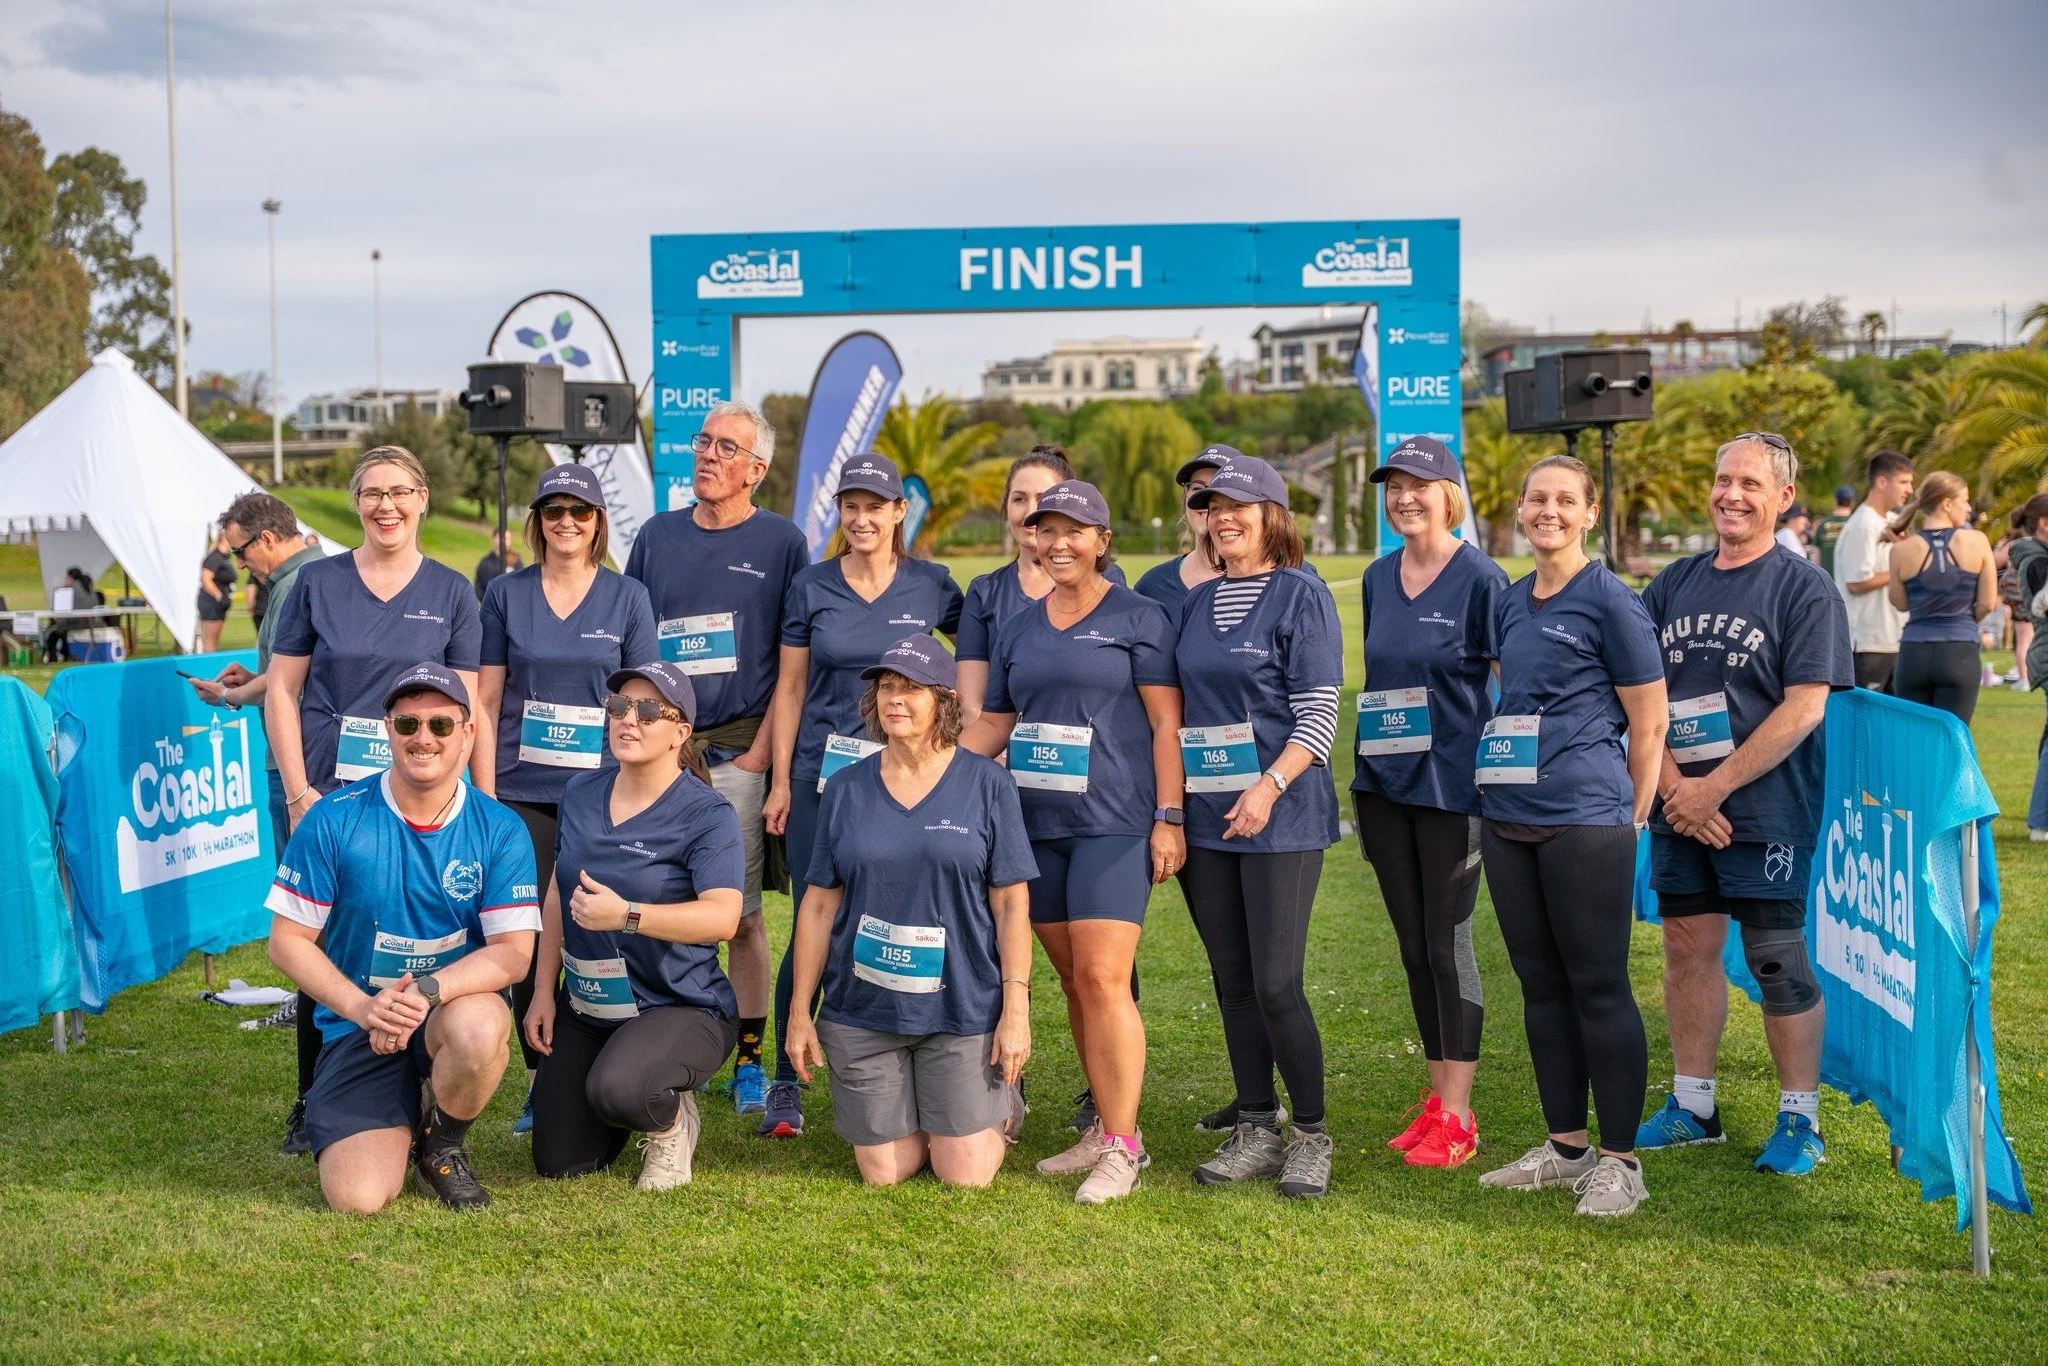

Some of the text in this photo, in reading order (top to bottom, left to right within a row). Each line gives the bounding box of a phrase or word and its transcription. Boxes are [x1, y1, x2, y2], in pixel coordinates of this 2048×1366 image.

[1315, 238, 1409, 270] Coastal
[1334, 241, 1356, 252] The
[709, 249, 800, 282] Coastal
[727, 254, 748, 264] The
[960, 245, 1143, 291] FINISH
[1387, 376, 1451, 398] PURE
[662, 388, 722, 408] PURE
[669, 476, 692, 485] TIM
[1661, 613, 1765, 652] HUFFER
[680, 636, 706, 650] 1169
[1668, 650, 1749, 668] 19 97
[1382, 712, 1406, 726] 1165
[1673, 720, 1698, 735] 1167
[547, 725, 576, 740] 1157
[155, 736, 184, 767] The
[1032, 745, 1059, 760] 1156
[1488, 740, 1511, 754] 1160
[1202, 749, 1228, 763] 1168
[132, 716, 253, 828] Coastal
[165, 851, 176, 866] 5K
[182, 847, 198, 860] 10K
[214, 831, 255, 853] MARATHON
[1826, 810, 1915, 949] Coastal
[881, 945, 912, 962] 1155
[404, 957, 437, 969] 1159
[1854, 953, 1864, 974] 10
[577, 978, 602, 993] 1164
